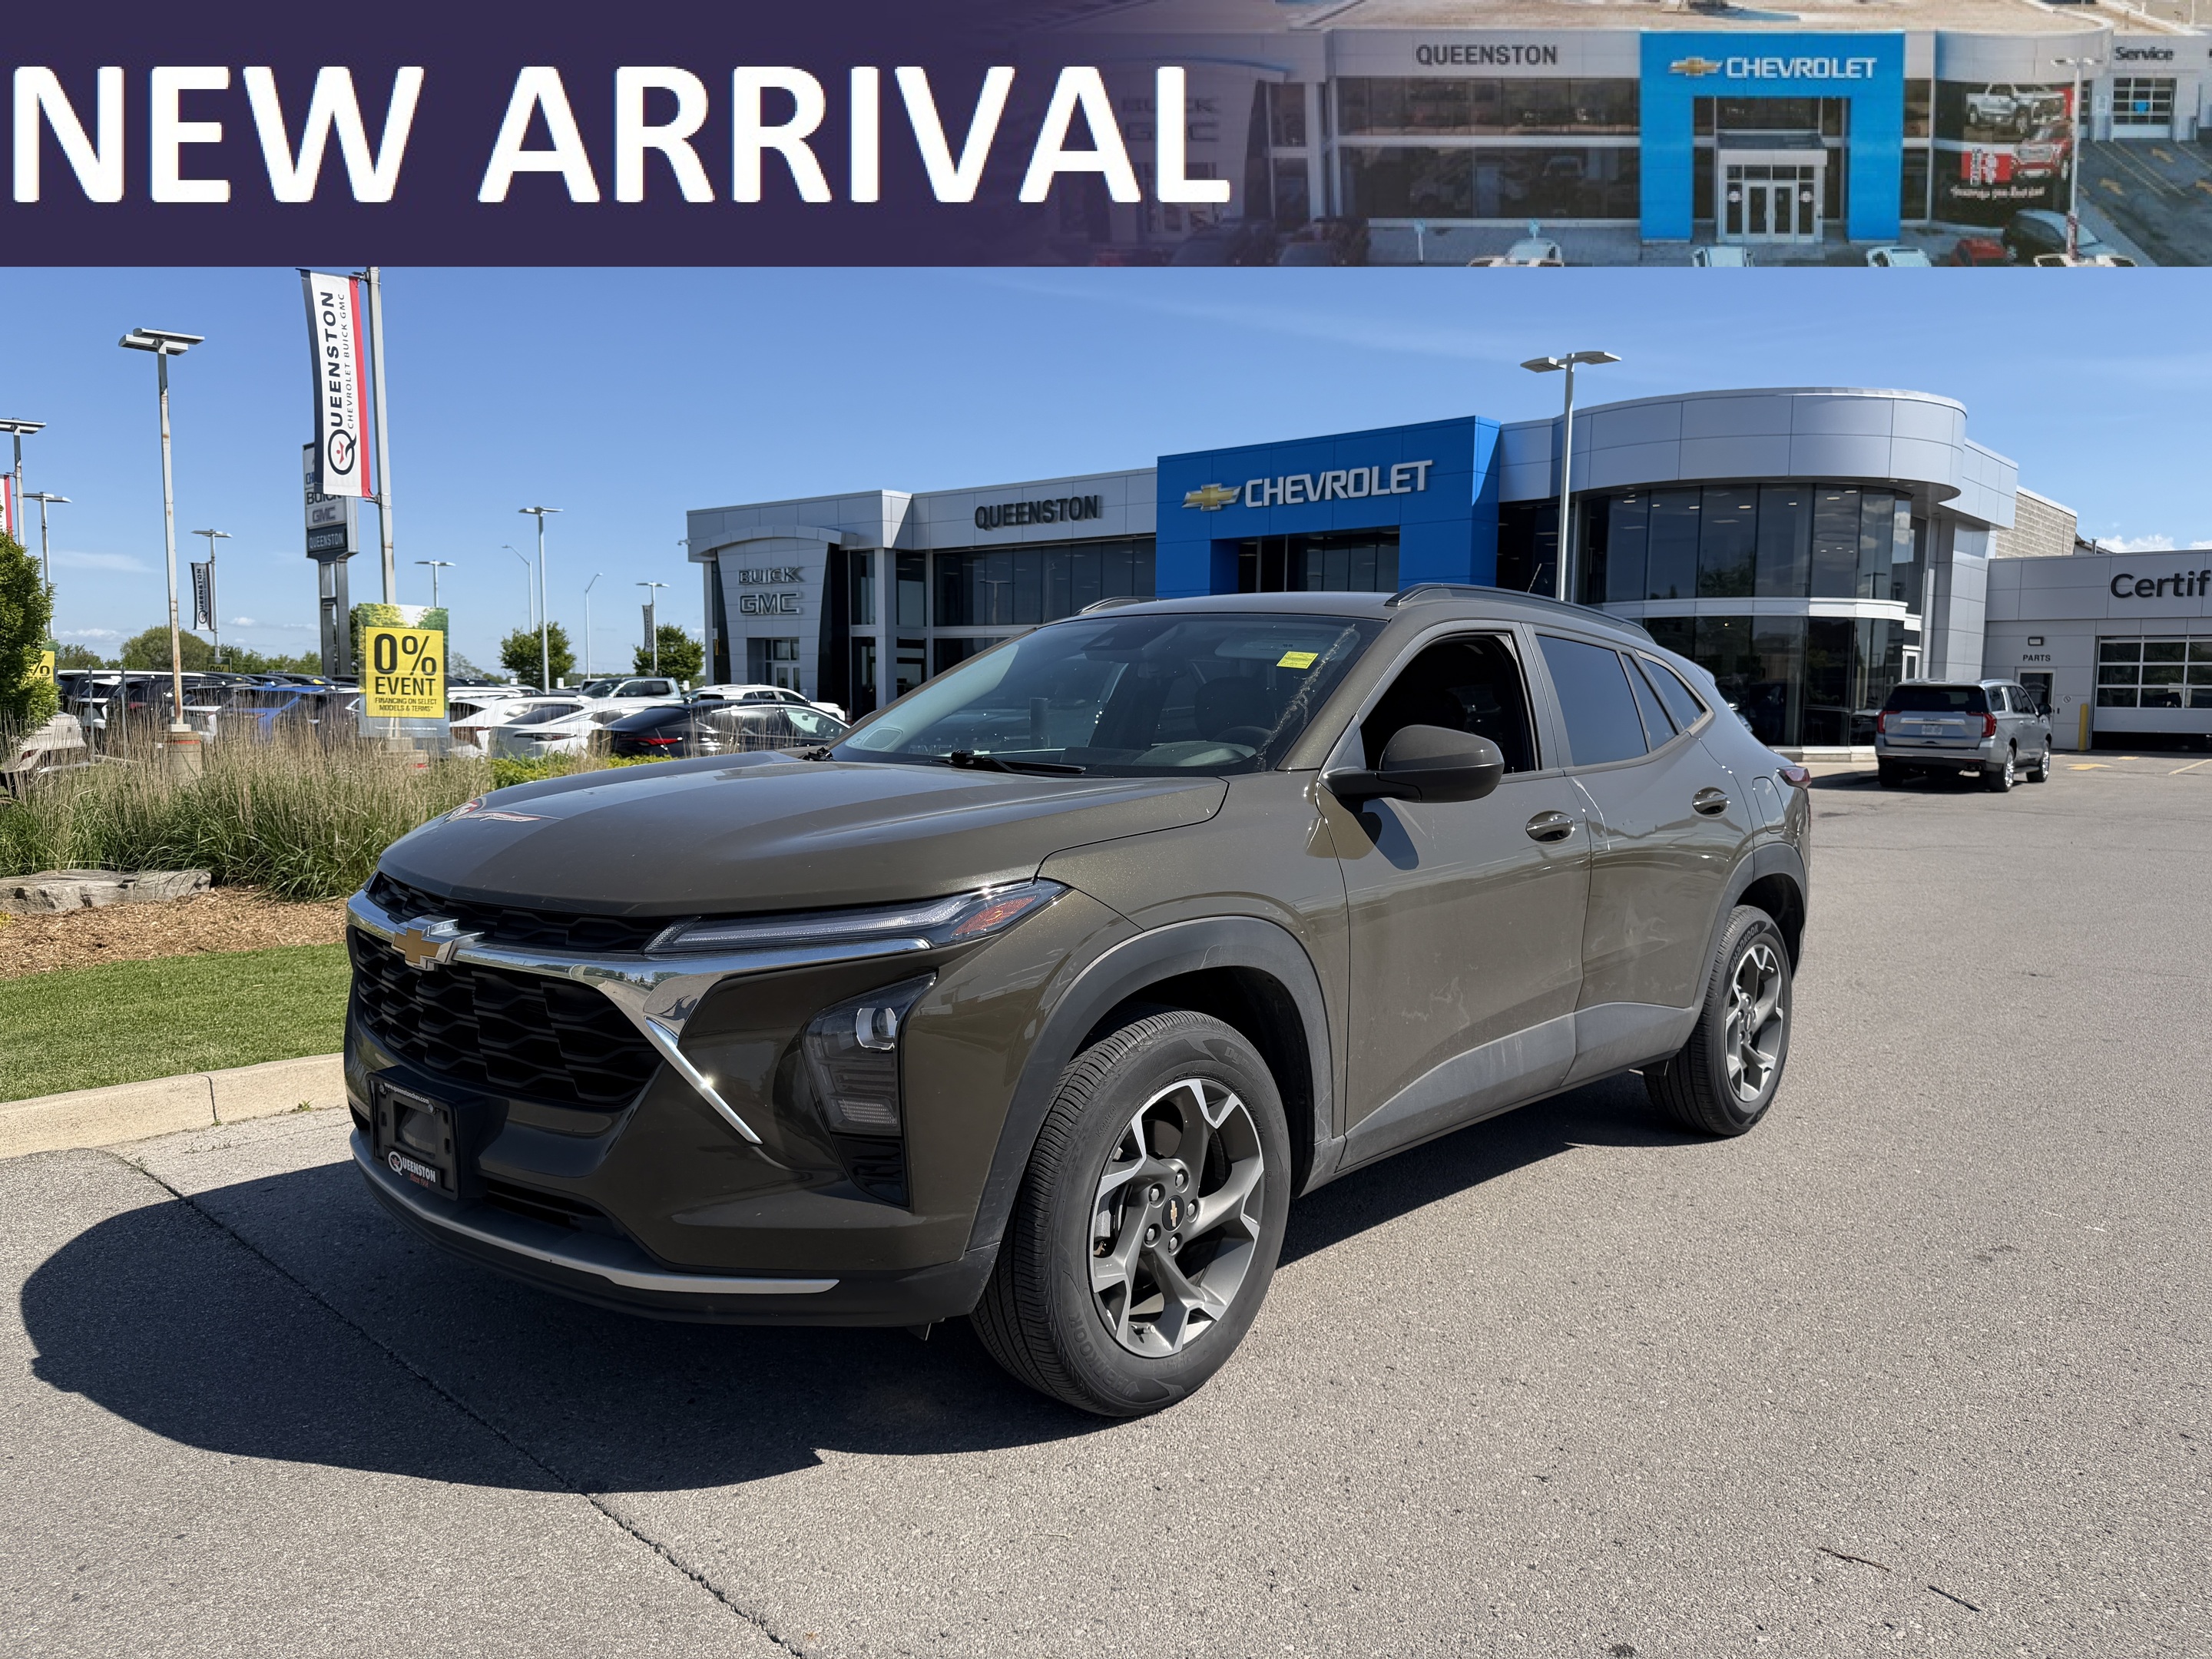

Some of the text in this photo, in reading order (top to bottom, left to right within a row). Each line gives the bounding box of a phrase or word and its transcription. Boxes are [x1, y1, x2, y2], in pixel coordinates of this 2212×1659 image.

[337, 293, 354, 429] CHEVROLET BUICK GMC
[320, 291, 357, 476] QUEENSTON
[1245, 459, 1433, 508] CHEVROLET
[312, 506, 336, 523] GMC
[975, 495, 1100, 531] QUEENSTON
[309, 532, 344, 549] QUEENSTON
[739, 566, 802, 585] BUICK
[197, 568, 208, 624] QUEENSTON
[740, 591, 800, 616] GMC
[374, 633, 437, 676] 0%
[2022, 654, 2051, 662] PARTS
[375, 677, 436, 696] EVENT
[388, 1151, 436, 1184] QUEENSTON
